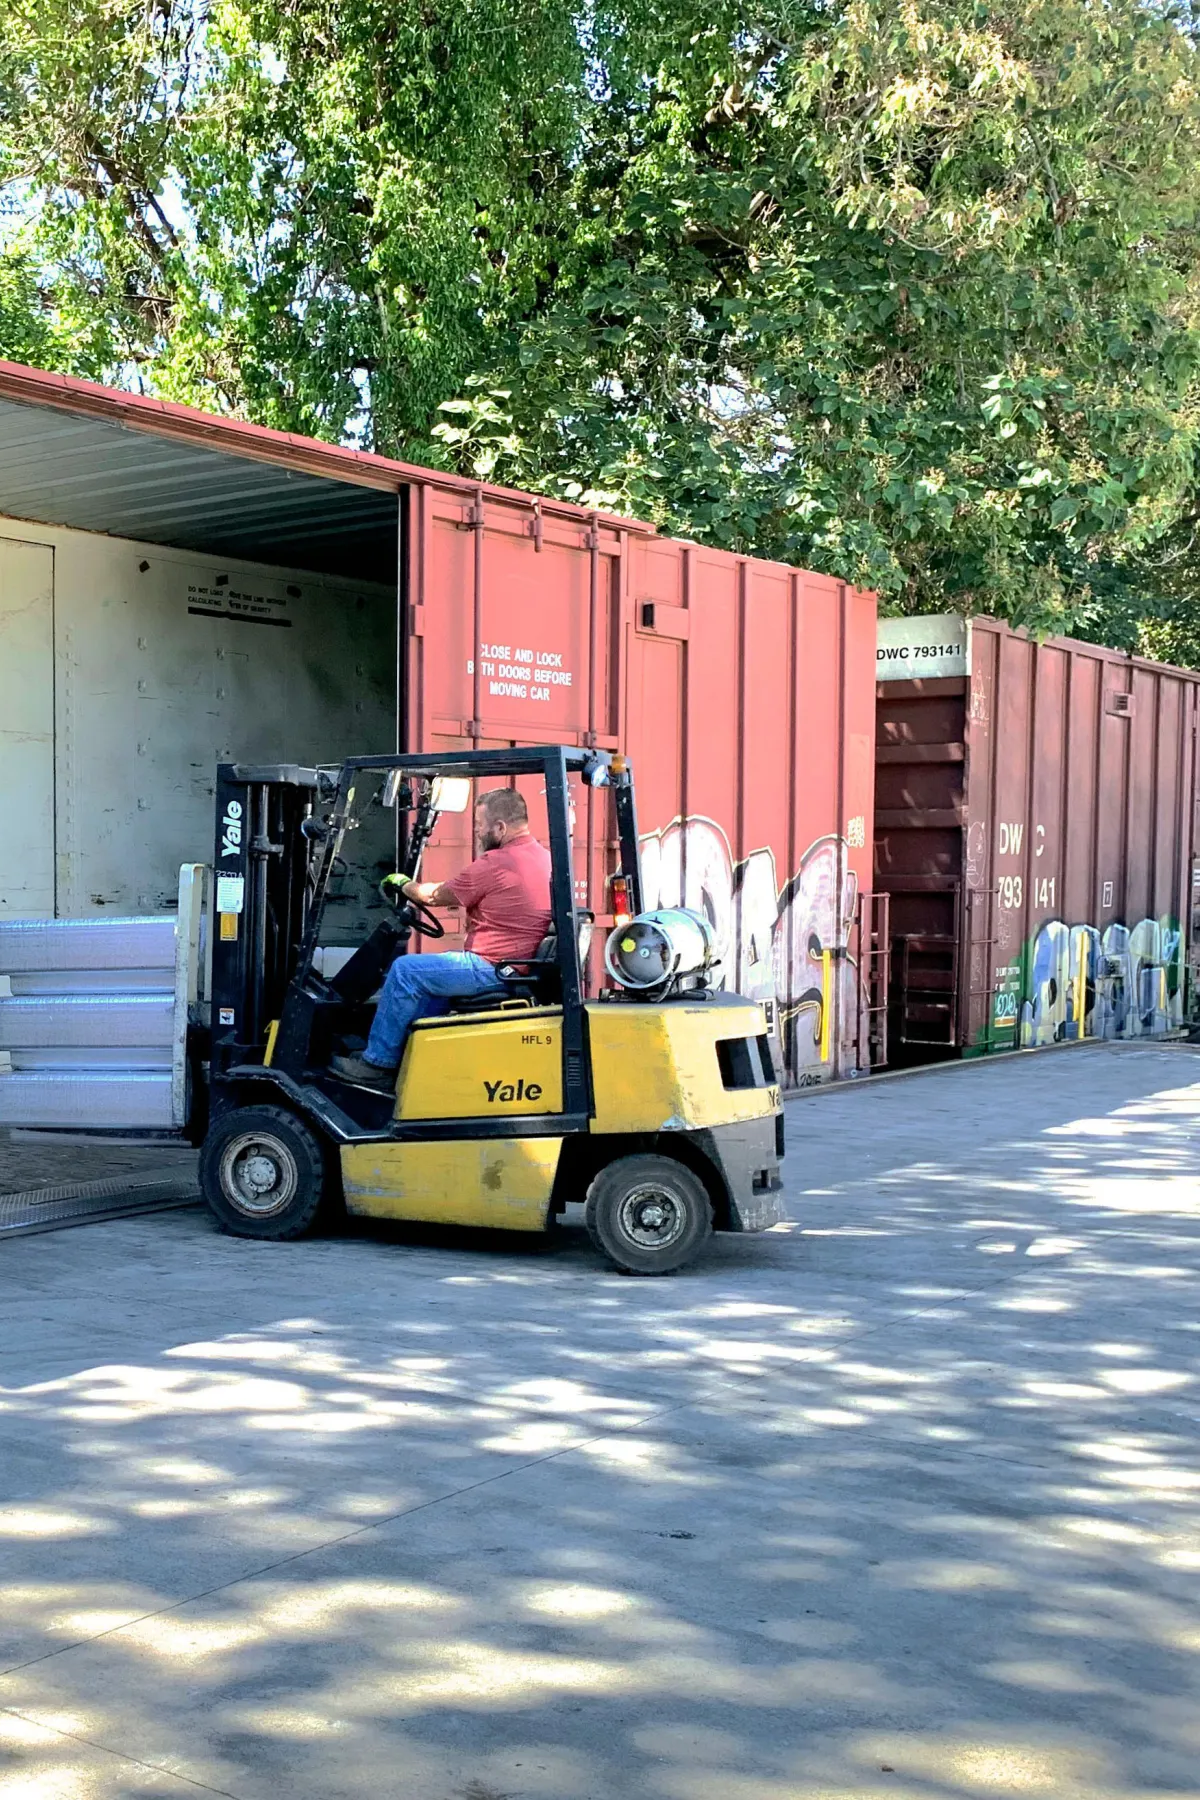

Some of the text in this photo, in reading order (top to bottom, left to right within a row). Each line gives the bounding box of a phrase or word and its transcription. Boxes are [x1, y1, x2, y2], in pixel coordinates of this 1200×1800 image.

[514, 648, 533, 663] AND
[536, 652, 562, 667] LOCK
[876, 644, 961, 660] DWC 793141
[467, 660, 572, 686] BTH DOORS BEFORE
[489, 681, 550, 701] MOVING CAR
[221, 800, 243, 857] Yale
[521, 1035, 552, 1045] HFL 9
[483, 1079, 542, 1103] Yale
